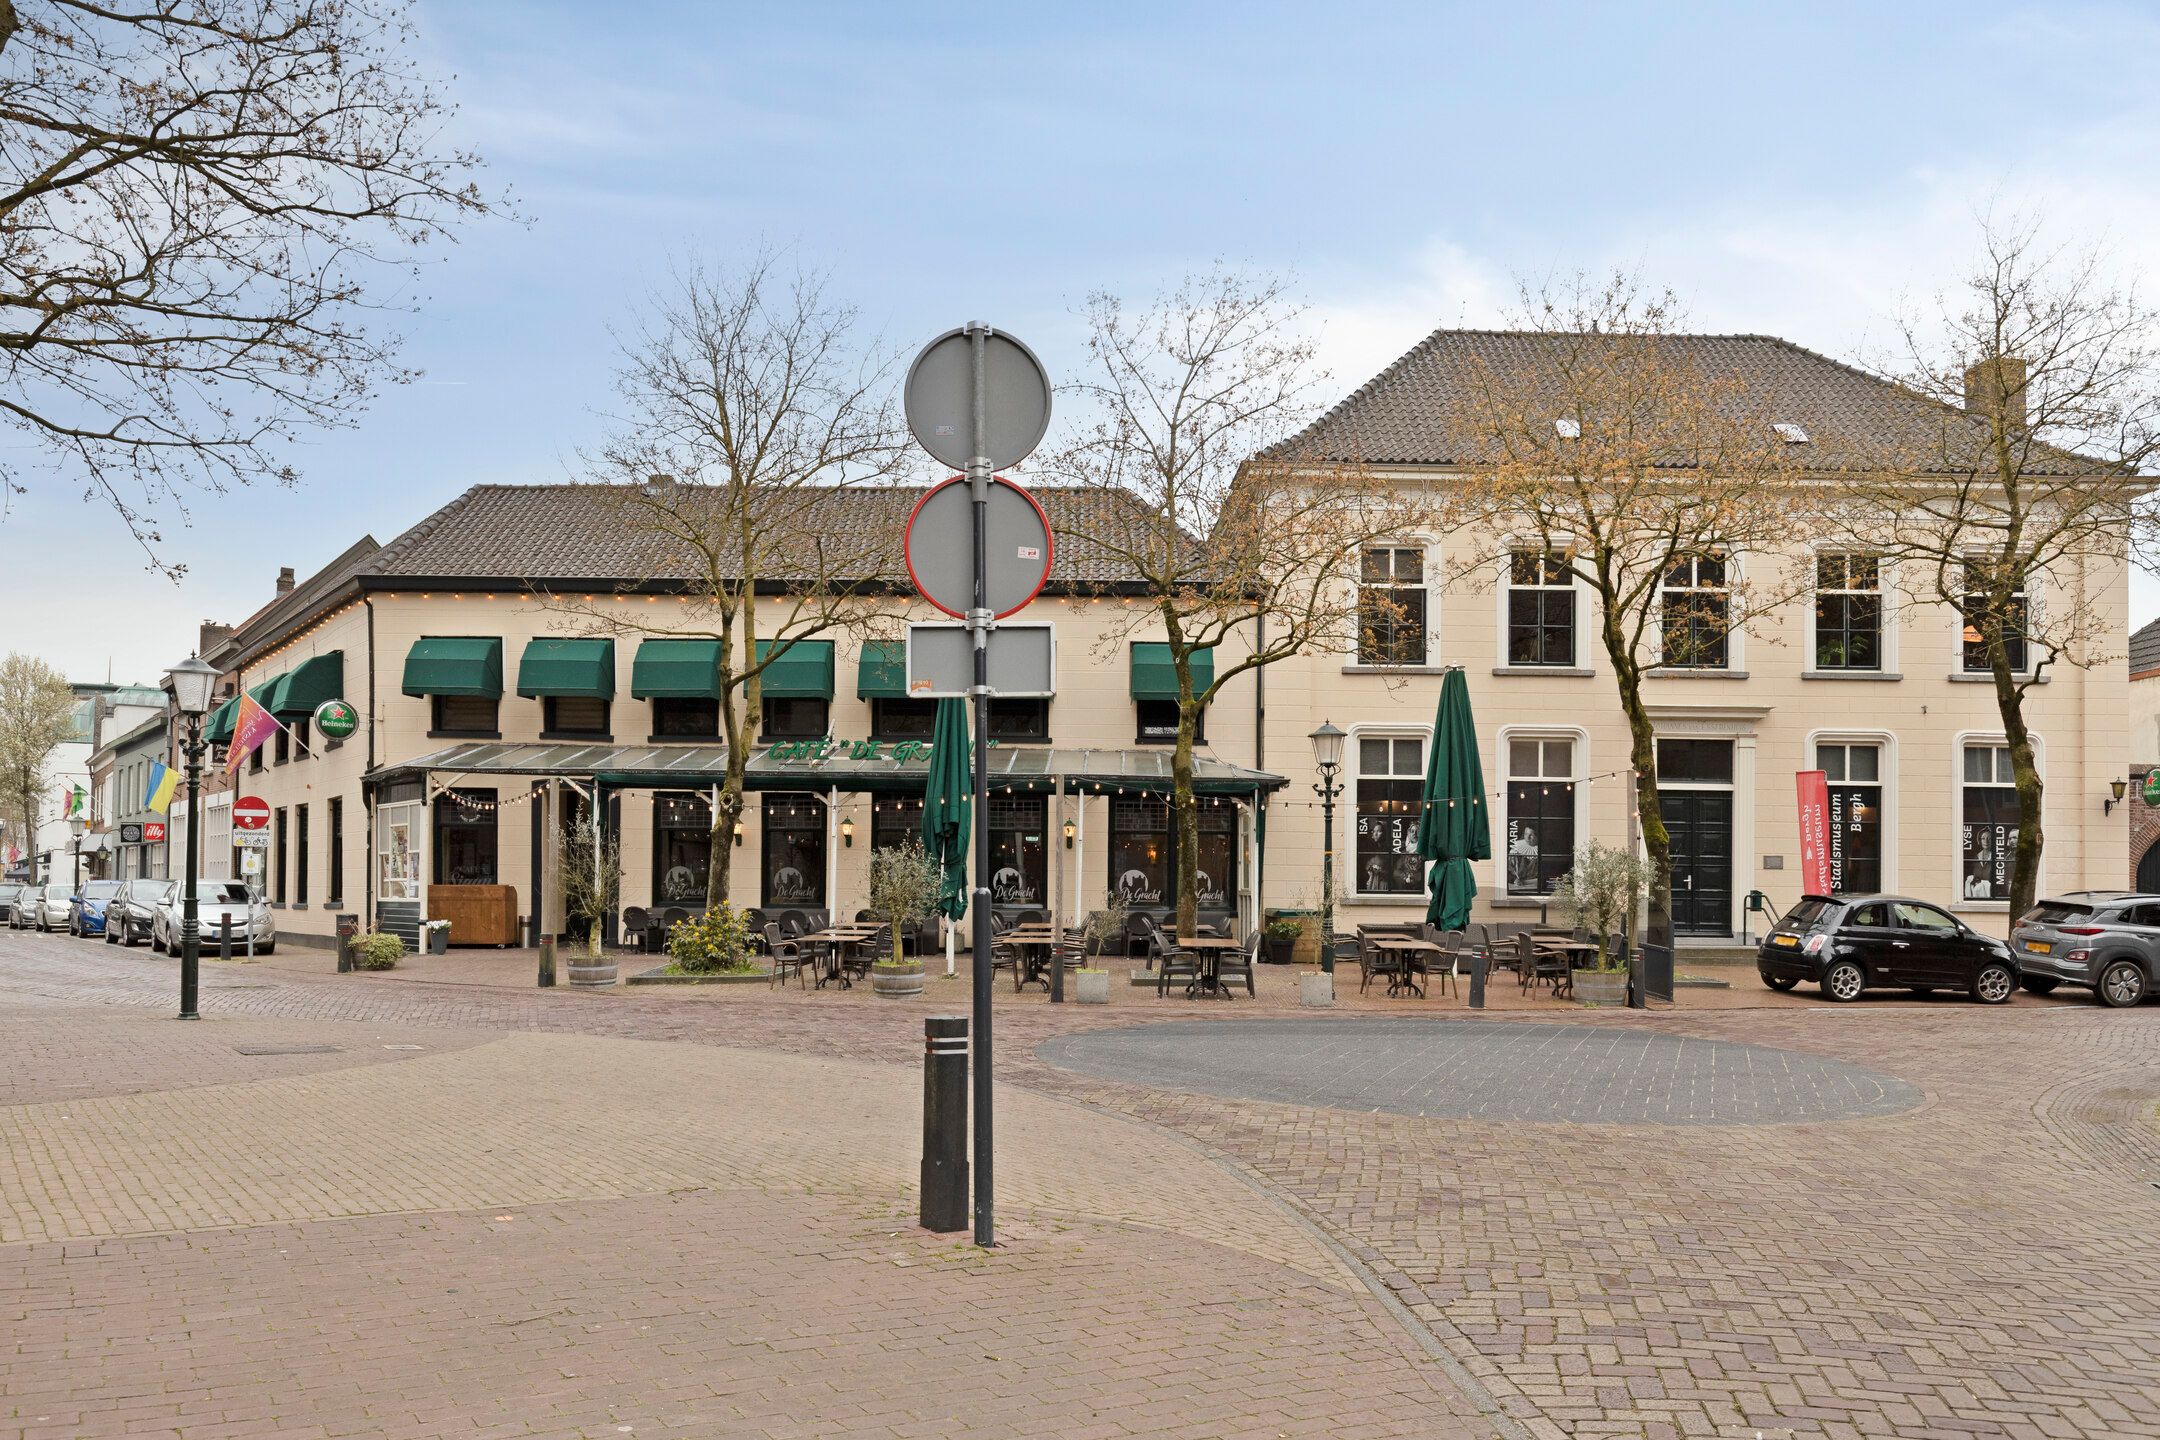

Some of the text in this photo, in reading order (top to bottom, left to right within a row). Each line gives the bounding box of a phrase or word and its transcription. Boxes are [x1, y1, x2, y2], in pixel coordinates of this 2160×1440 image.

[321, 719, 354, 728] Heineken
[768, 735, 831, 760] CAFÉ
[1850, 793, 1865, 832] Bergh
[146, 825, 164, 839] illy
[1358, 817, 1368, 834] ISA
[1392, 818, 1402, 854] ADELA
[1509, 820, 1519, 853] MARIA
[1829, 793, 1842, 889] Stadsmuseum
[1963, 825, 1973, 850] LYSE
[1995, 826, 2005, 885] MECHTELD
[775, 884, 816, 900] De Gracht
[994, 885, 1036, 900] De Gracht
[1120, 886, 1161, 903] De Gracht
[1197, 888, 1225, 903] Gracht
